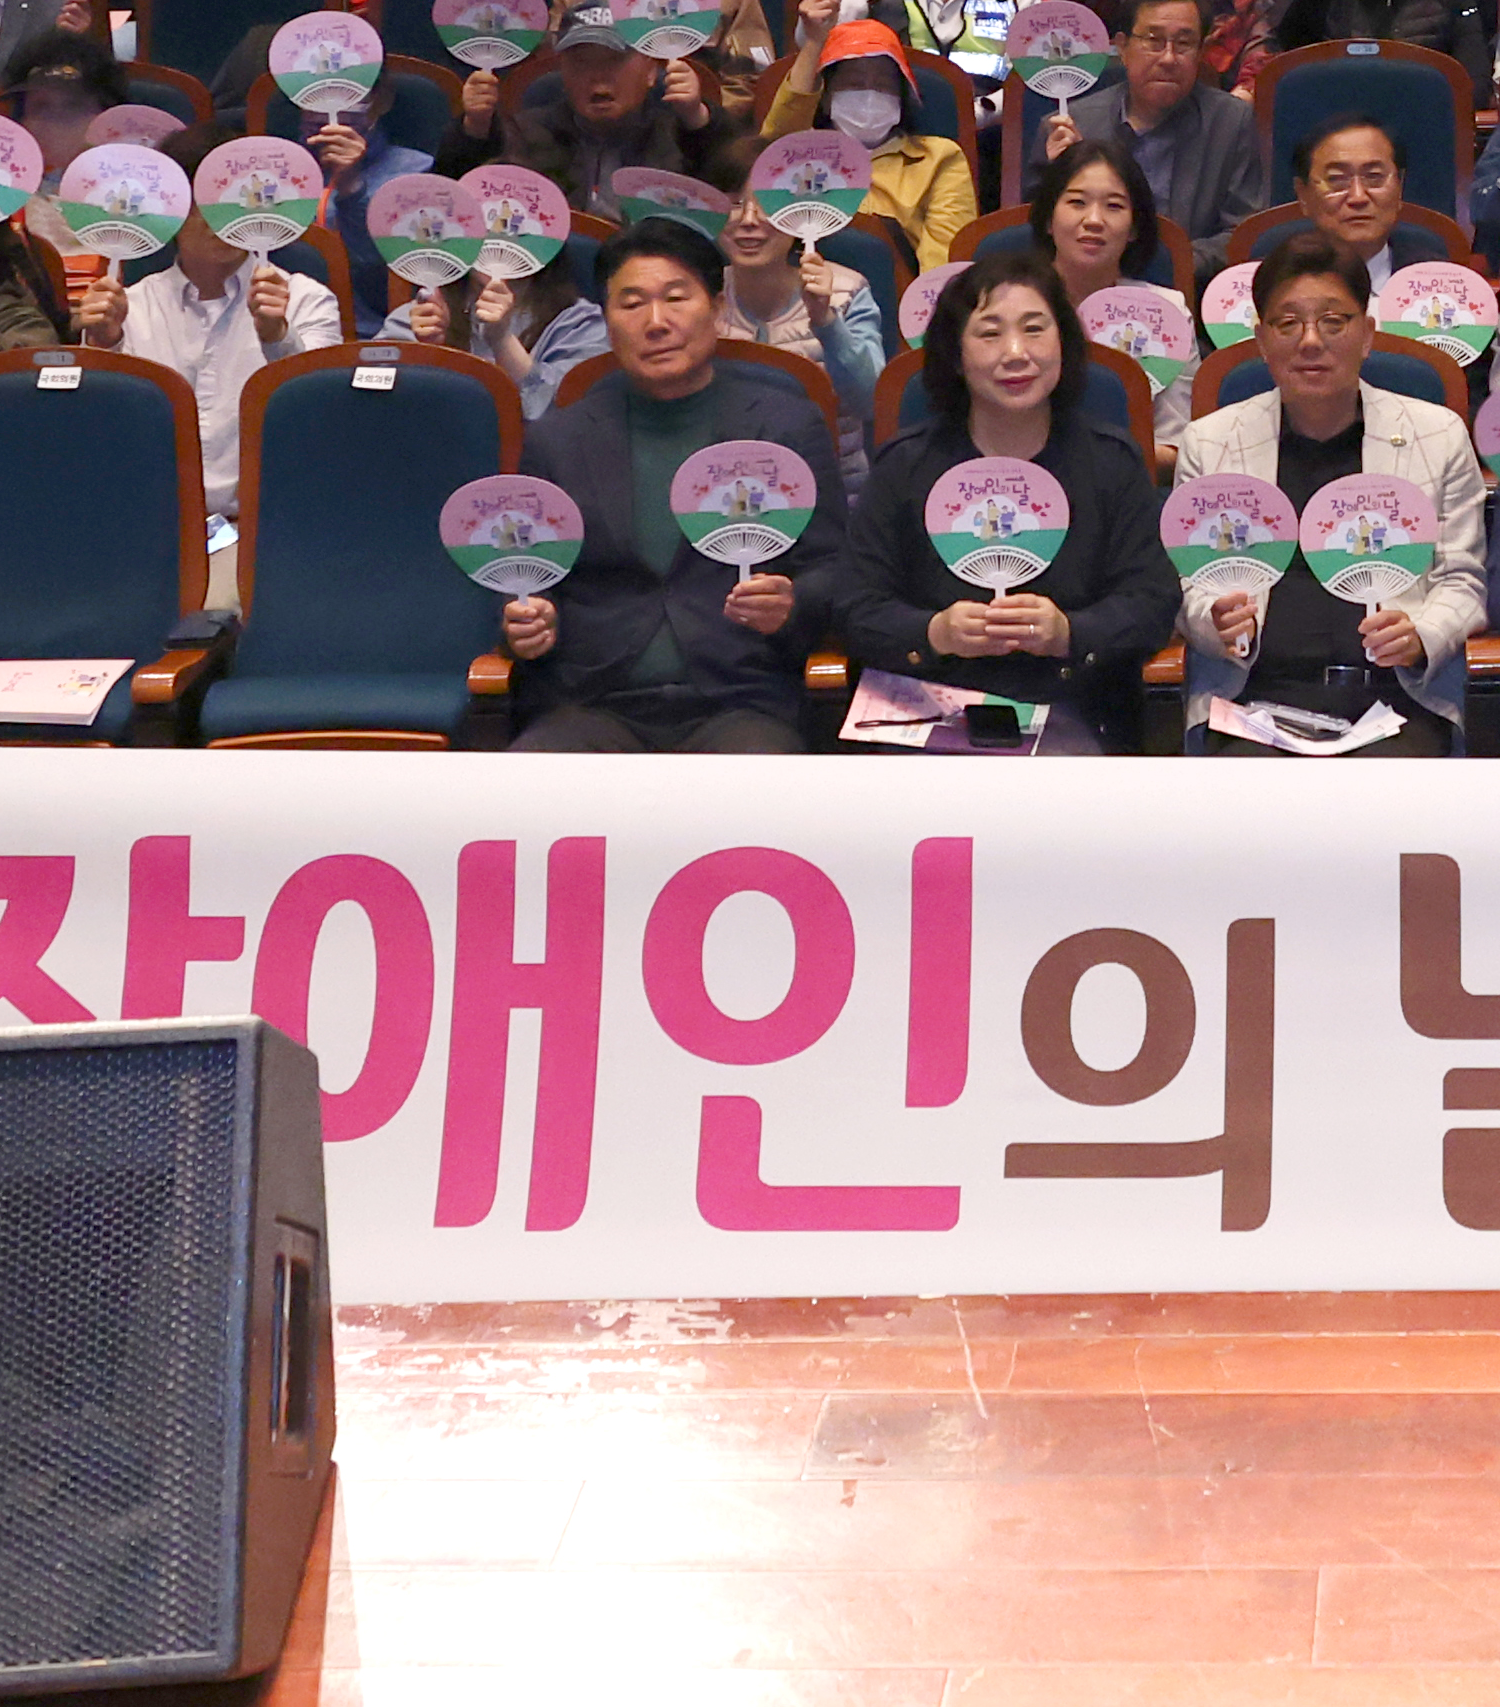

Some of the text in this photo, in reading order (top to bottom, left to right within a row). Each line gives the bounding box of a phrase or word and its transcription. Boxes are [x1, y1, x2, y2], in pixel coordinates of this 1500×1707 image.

[268, 159, 289, 179] 날
[523, 190, 539, 212] 날
[1409, 279, 1468, 304] 장애인의 날
[1149, 310, 1164, 335] 날
[40, 374, 80, 384] 국회의원
[958, 478, 1031, 506] 장애인의 날
[1192, 493, 1260, 520] 장애인의 날
[1331, 494, 1400, 521] 장애인의 날
